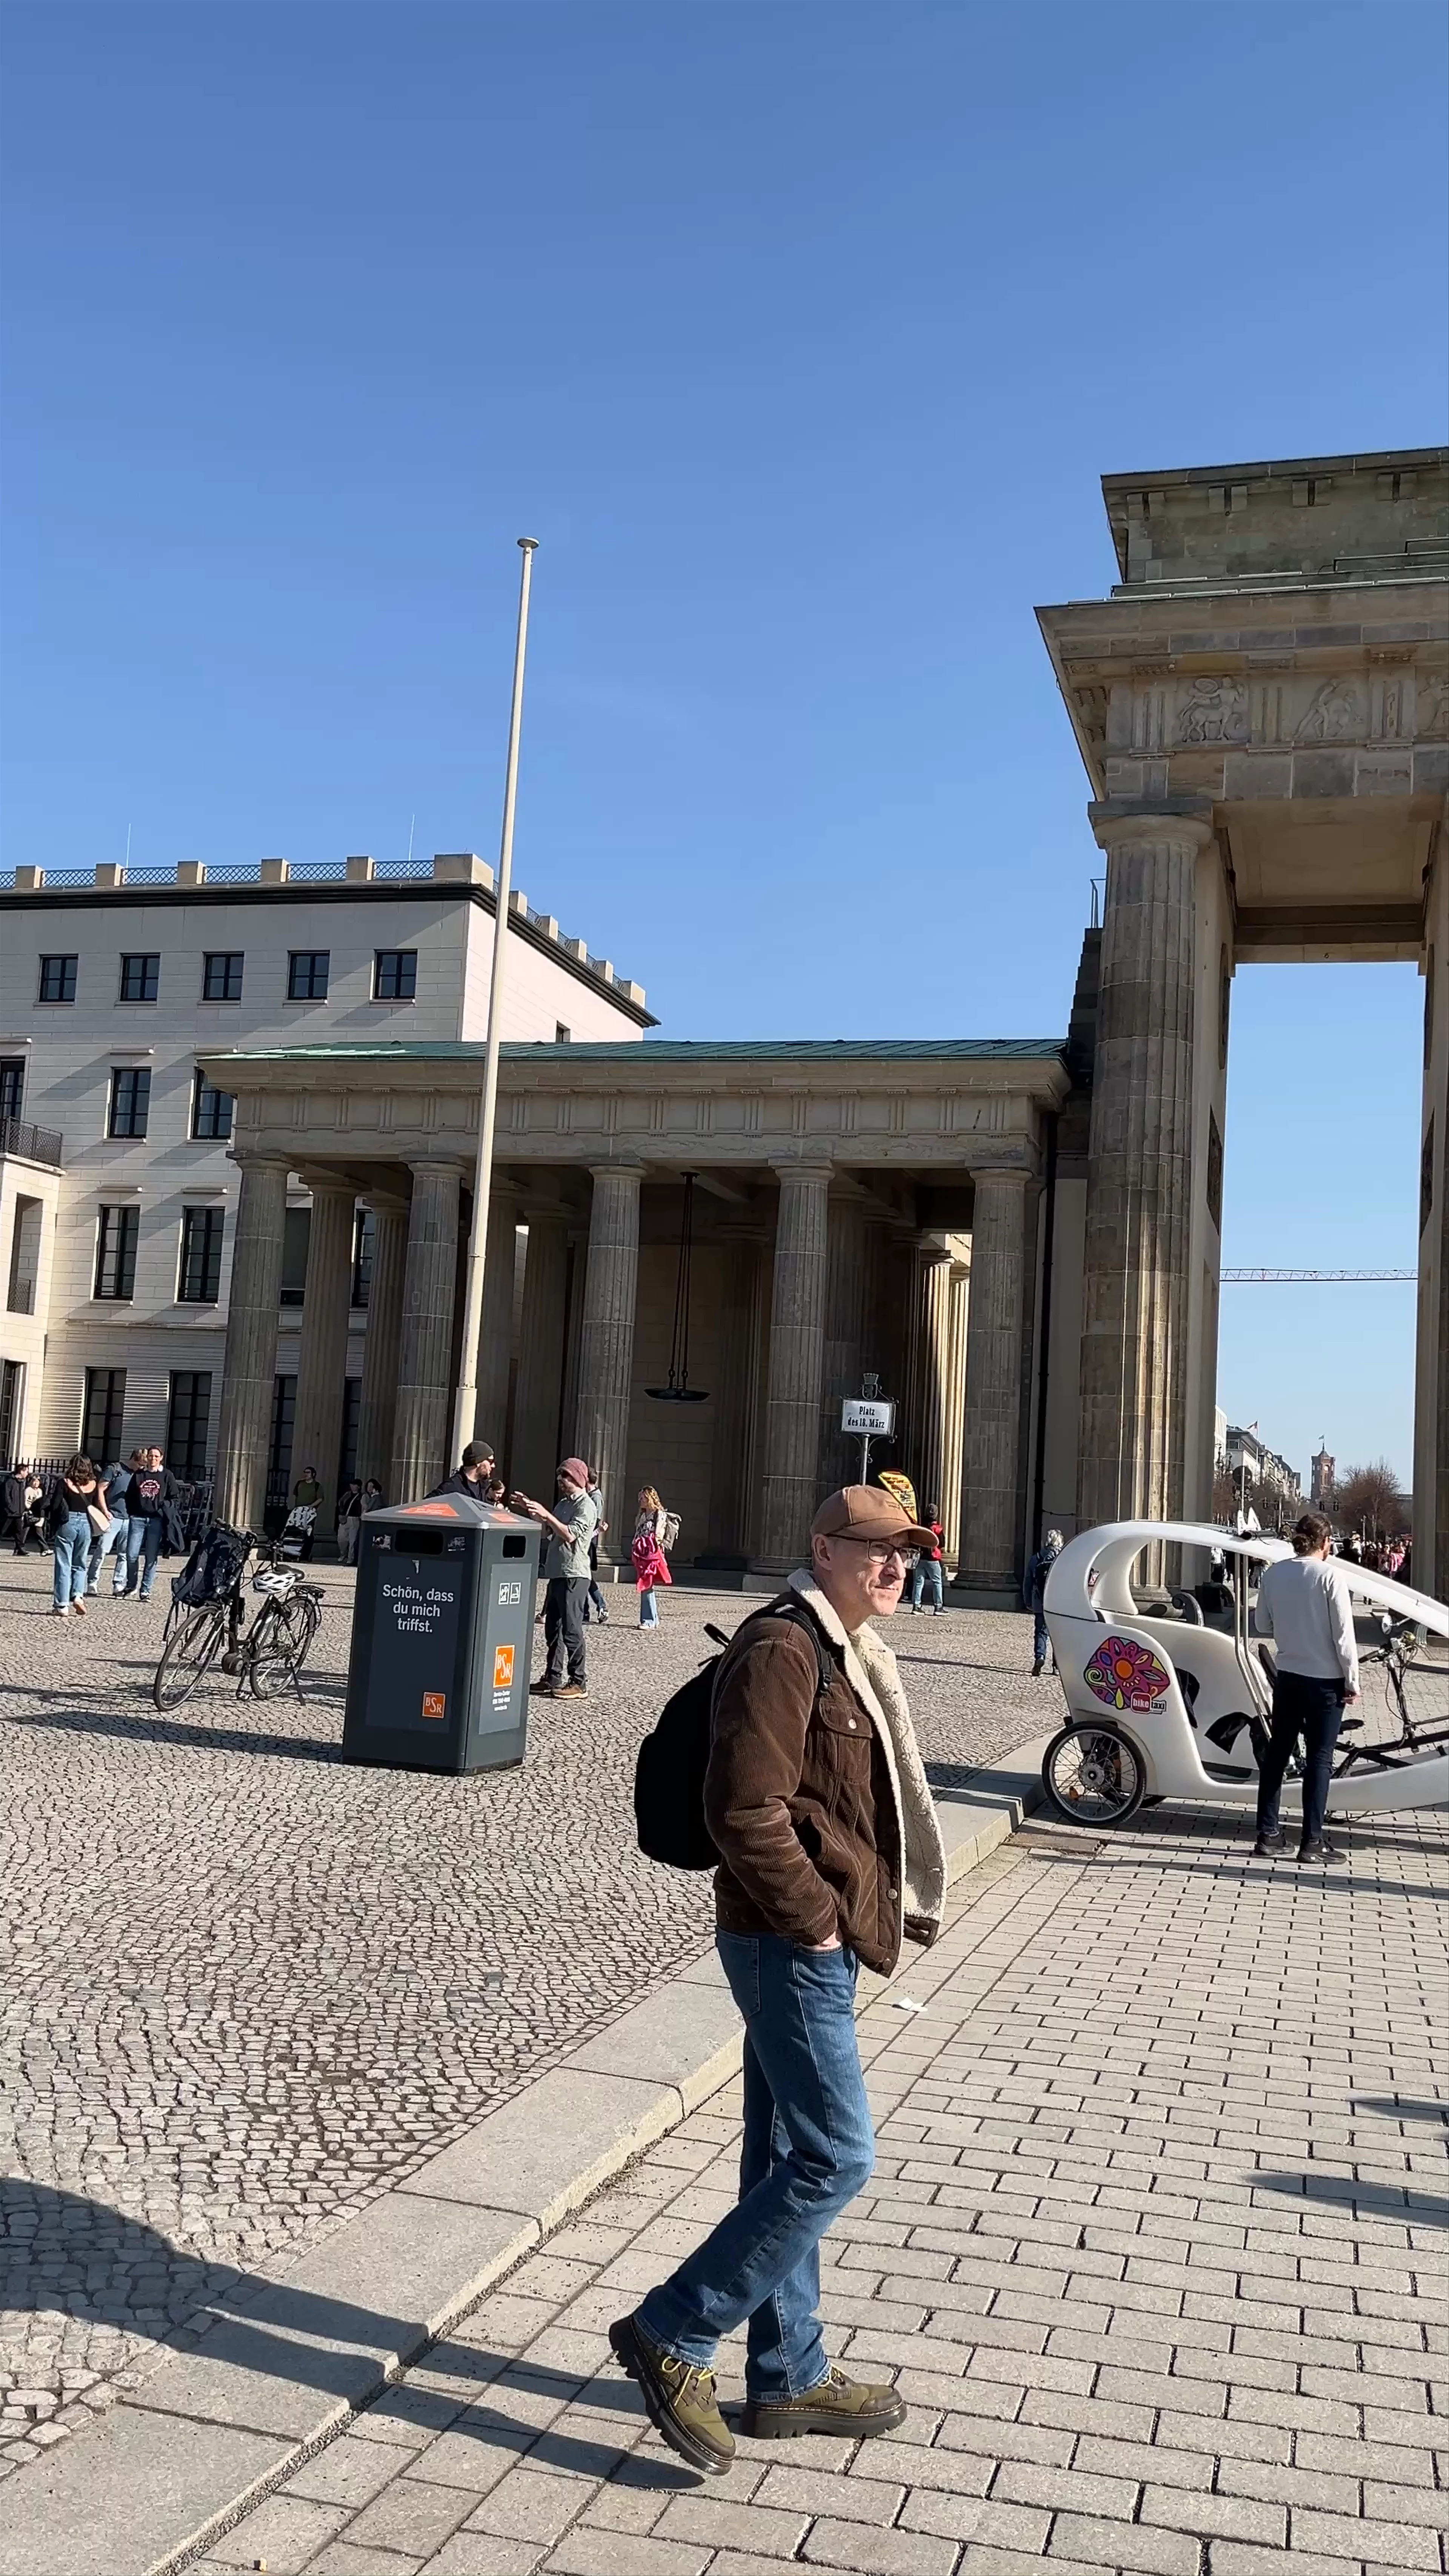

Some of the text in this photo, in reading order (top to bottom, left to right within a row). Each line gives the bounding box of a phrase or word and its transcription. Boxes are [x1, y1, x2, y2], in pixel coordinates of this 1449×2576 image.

[859, 1406, 875, 1416] Platz
[848, 1417, 858, 1426] des
[869, 1418, 885, 1428] März
[383, 1584, 454, 1602] Schön, dass
[393, 1601, 440, 1617] du mich
[398, 1618, 432, 1633] triffst.
[497, 1653, 511, 1679] BSR
[426, 1697, 442, 1713] BSR
[1133, 1698, 1149, 1708] bike
